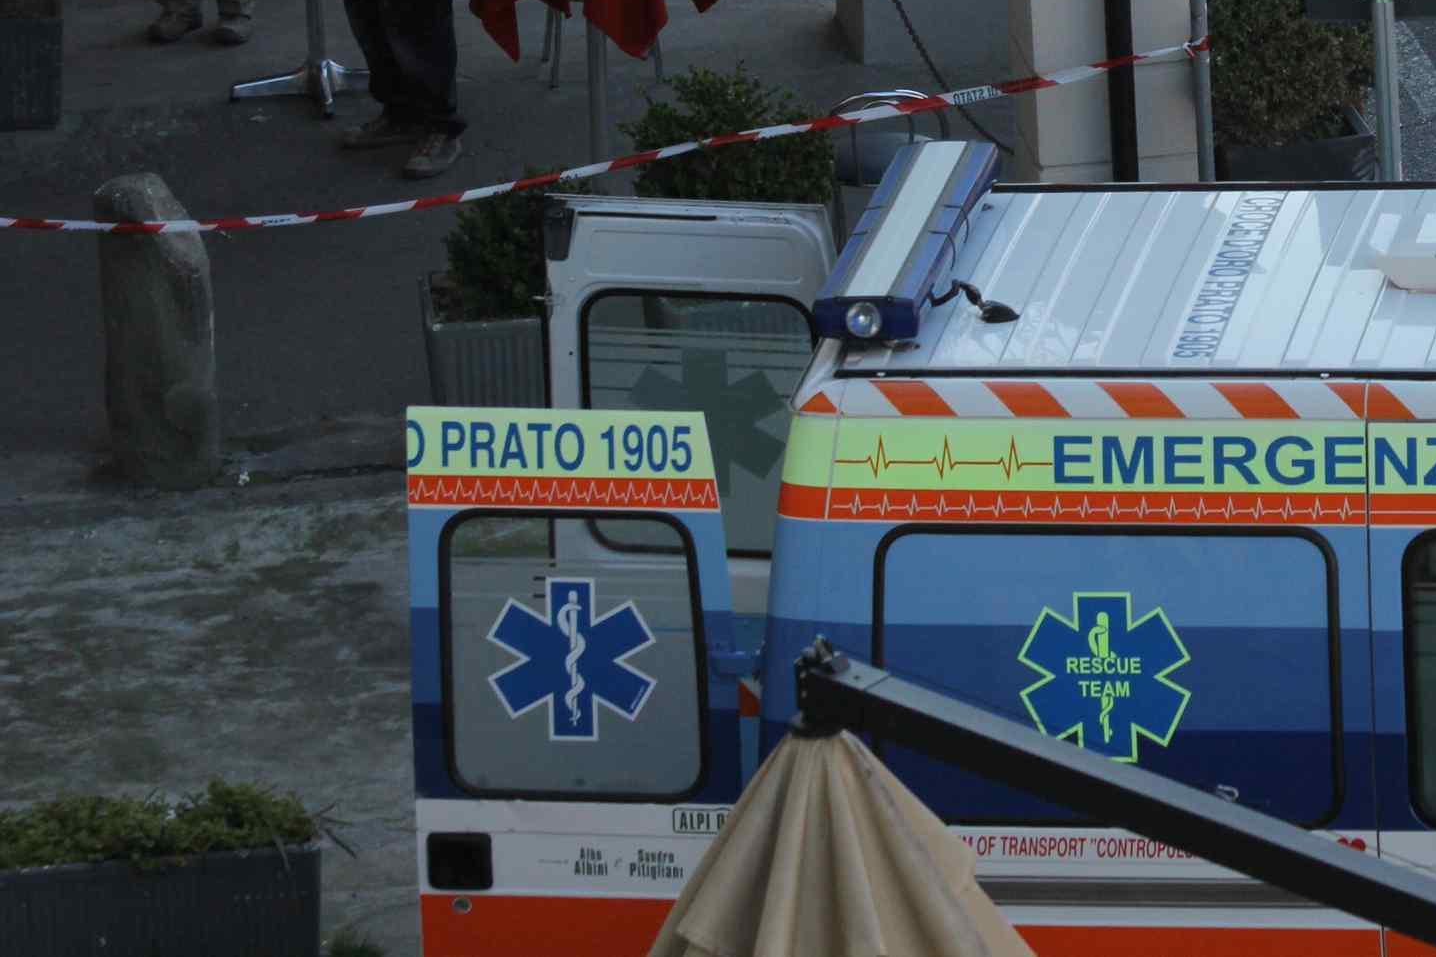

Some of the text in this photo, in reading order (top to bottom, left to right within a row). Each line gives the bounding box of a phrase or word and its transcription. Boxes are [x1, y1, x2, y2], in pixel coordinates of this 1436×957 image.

[1229, 197, 1283, 236] CROCE
[1188, 281, 1245, 324] PRATO
[1173, 328, 1222, 358] 1905
[441, 421, 585, 471] PRATO
[600, 424, 693, 472] 1905
[1066, 656, 1143, 675] RESCUE
[1078, 680, 1131, 697] TEAM
[680, 812, 710, 830] ALPI
[976, 836, 997, 857] OF
[1001, 837, 1087, 858] TRANSPORT
